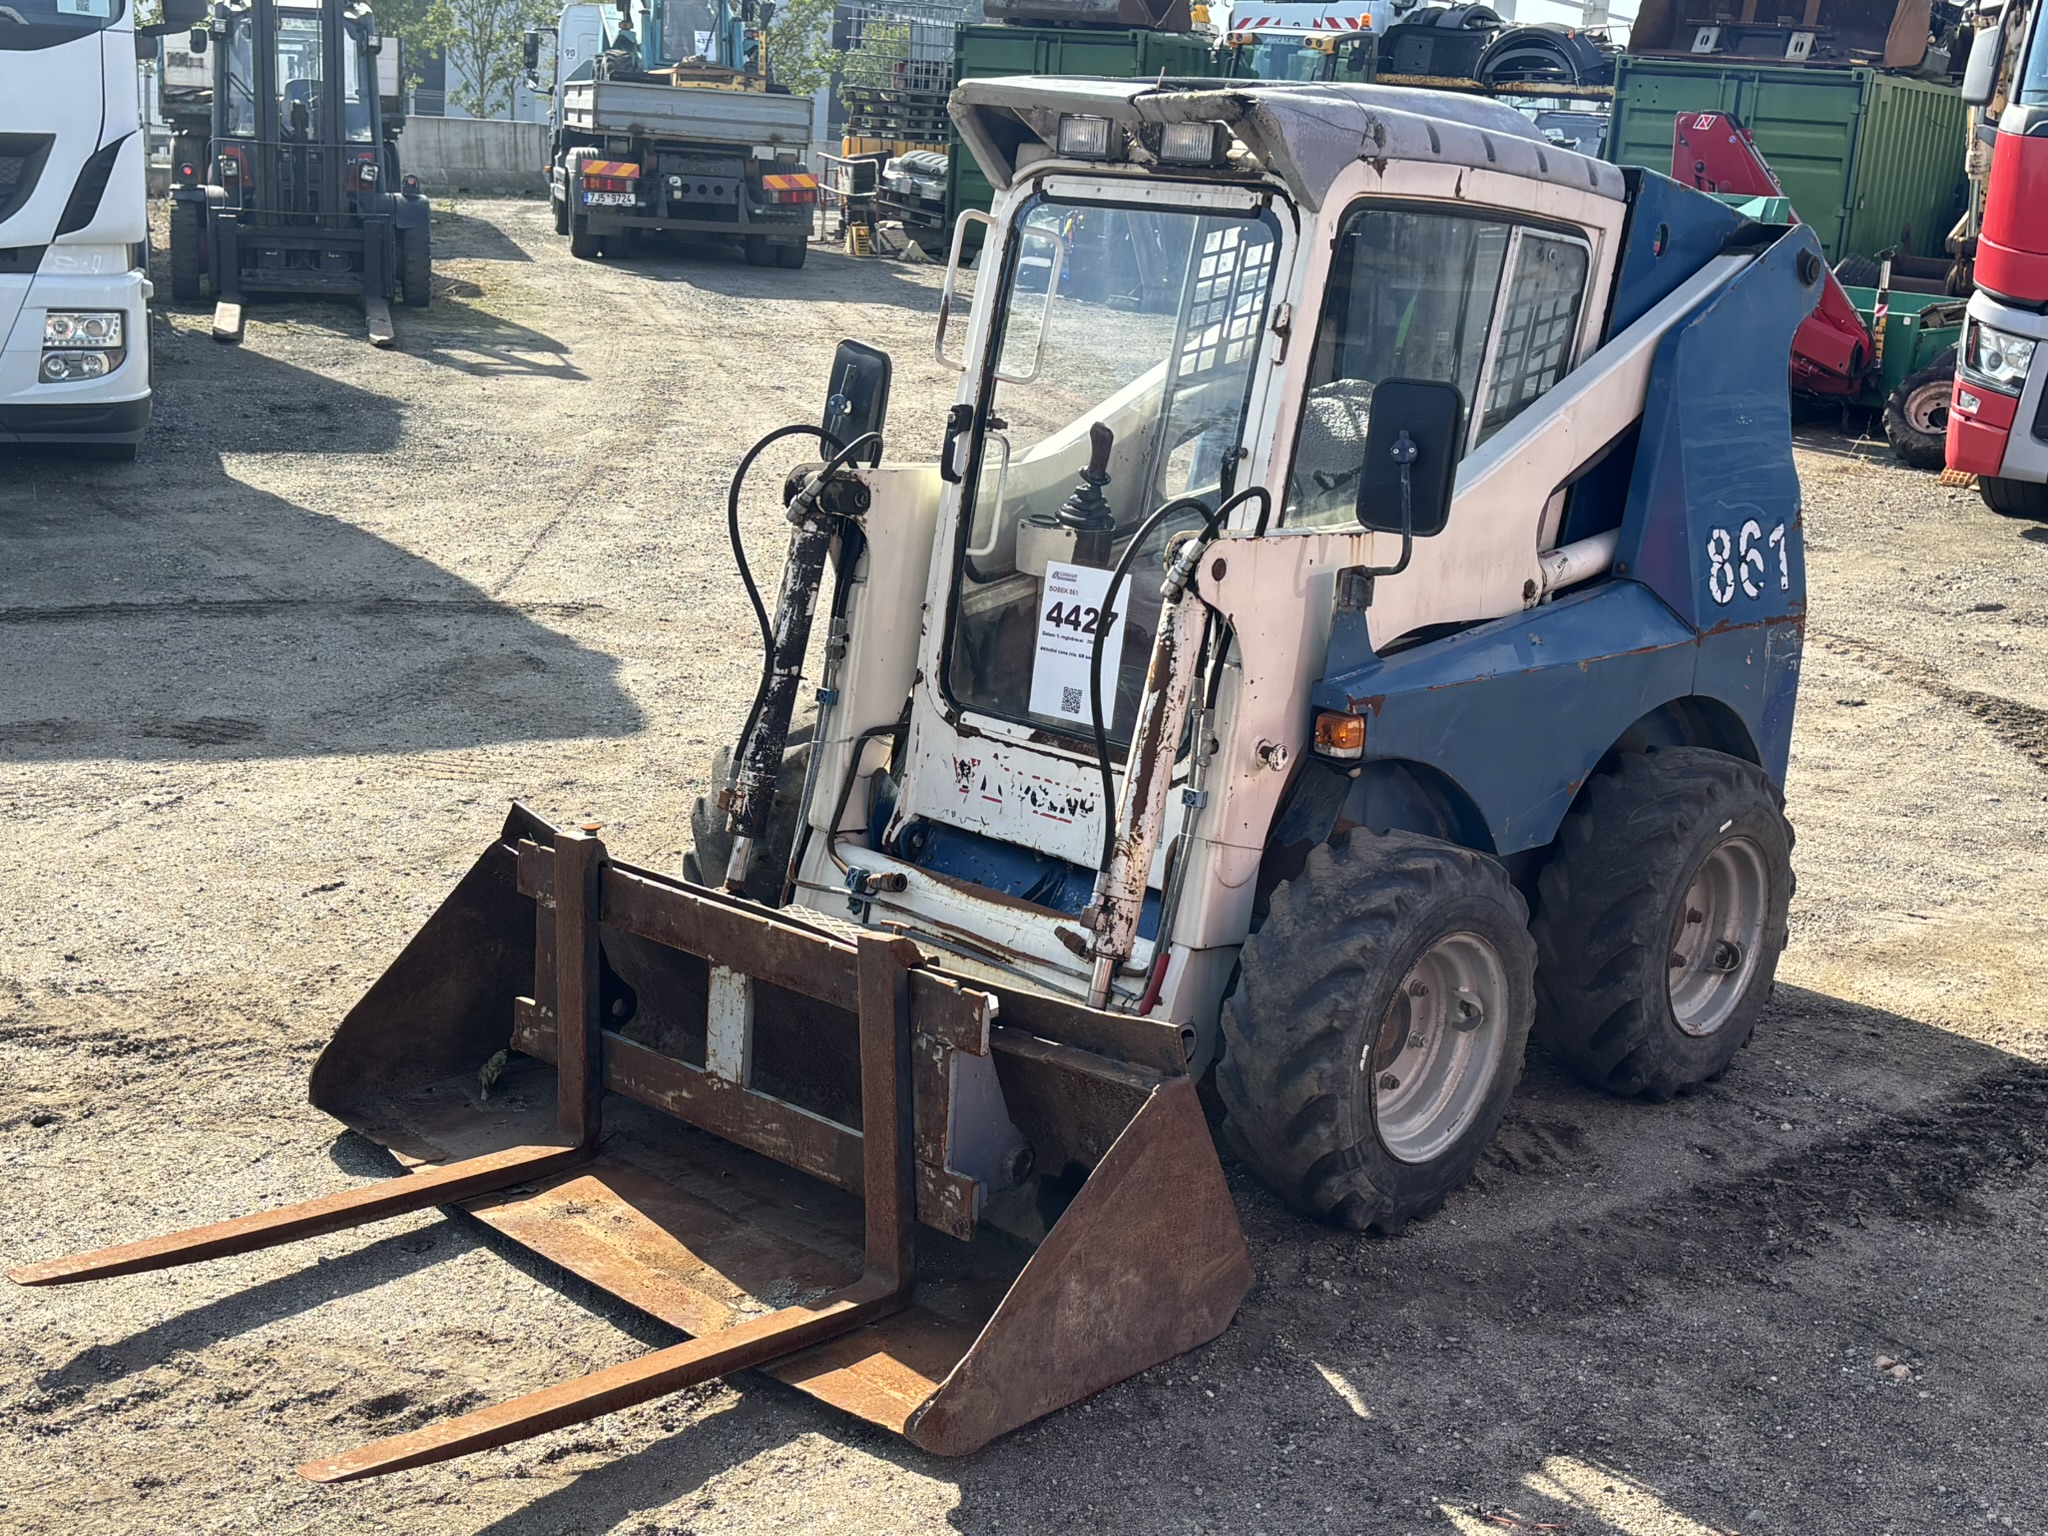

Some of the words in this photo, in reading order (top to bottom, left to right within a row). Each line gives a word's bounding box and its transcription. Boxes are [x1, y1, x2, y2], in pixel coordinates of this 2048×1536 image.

[565, 48, 576, 57] 90
[590, 193, 606, 202] 7J5
[611, 194, 632, 203] 9724
[1706, 519, 1789, 604] 861
